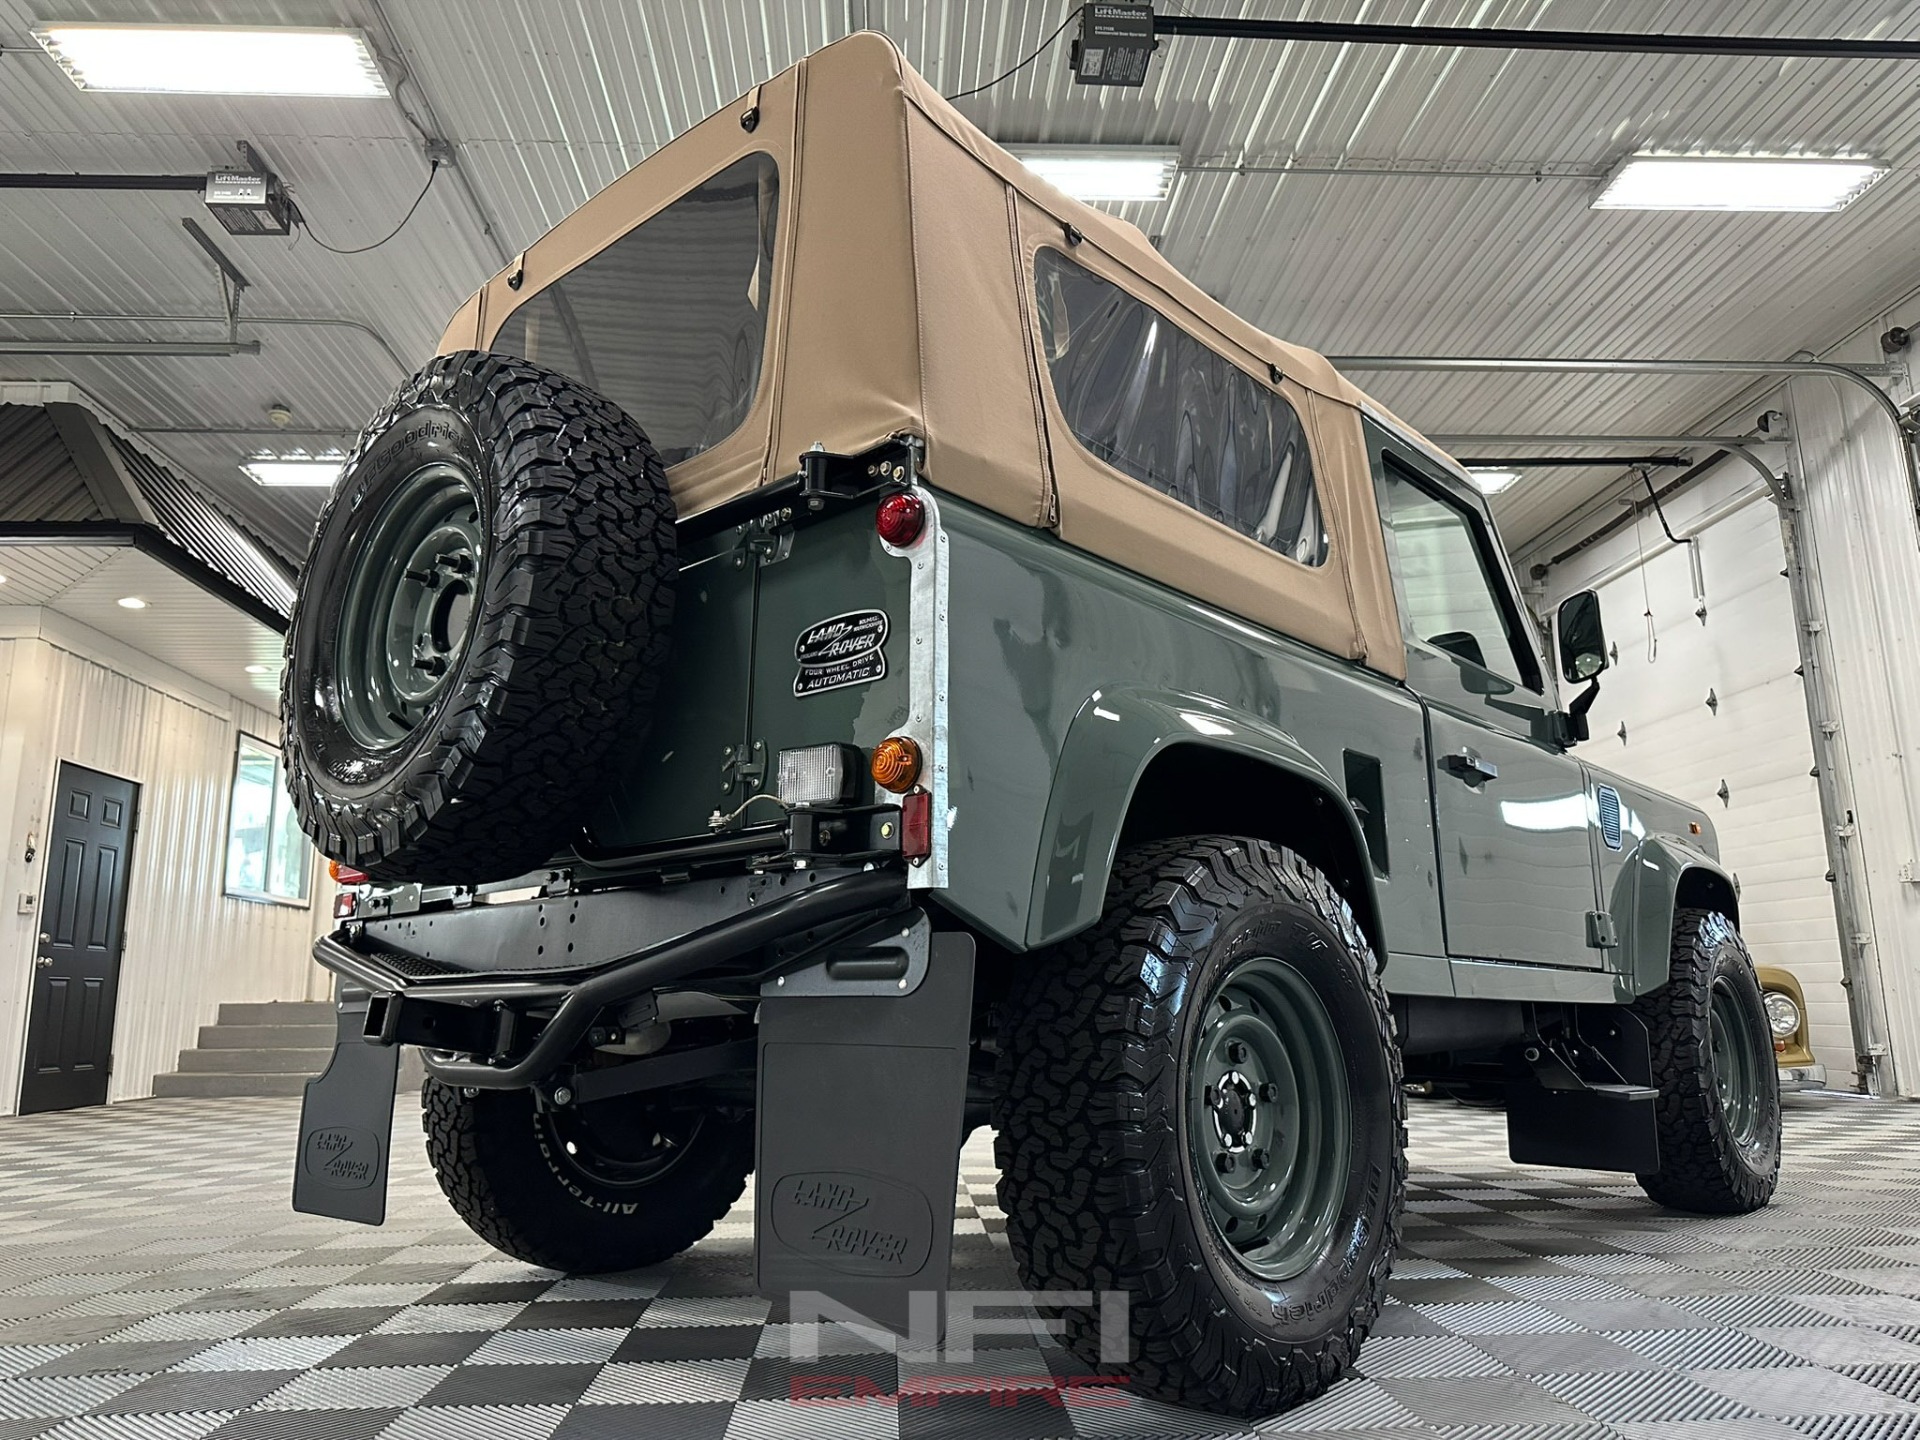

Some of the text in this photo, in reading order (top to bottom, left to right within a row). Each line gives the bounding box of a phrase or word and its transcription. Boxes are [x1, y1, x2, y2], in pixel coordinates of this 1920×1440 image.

[1094, 8, 1147, 17] LiftMaster
[215, 174, 262, 182] LiftMaster
[807, 622, 847, 645] LAND
[829, 633, 876, 657] ROVER
[804, 653, 875, 676] FOUR WHEEL DRIVE
[806, 666, 872, 690] AUTOMATIC
[794, 1180, 855, 1213] LAND
[827, 1226, 908, 1265] ROVER
